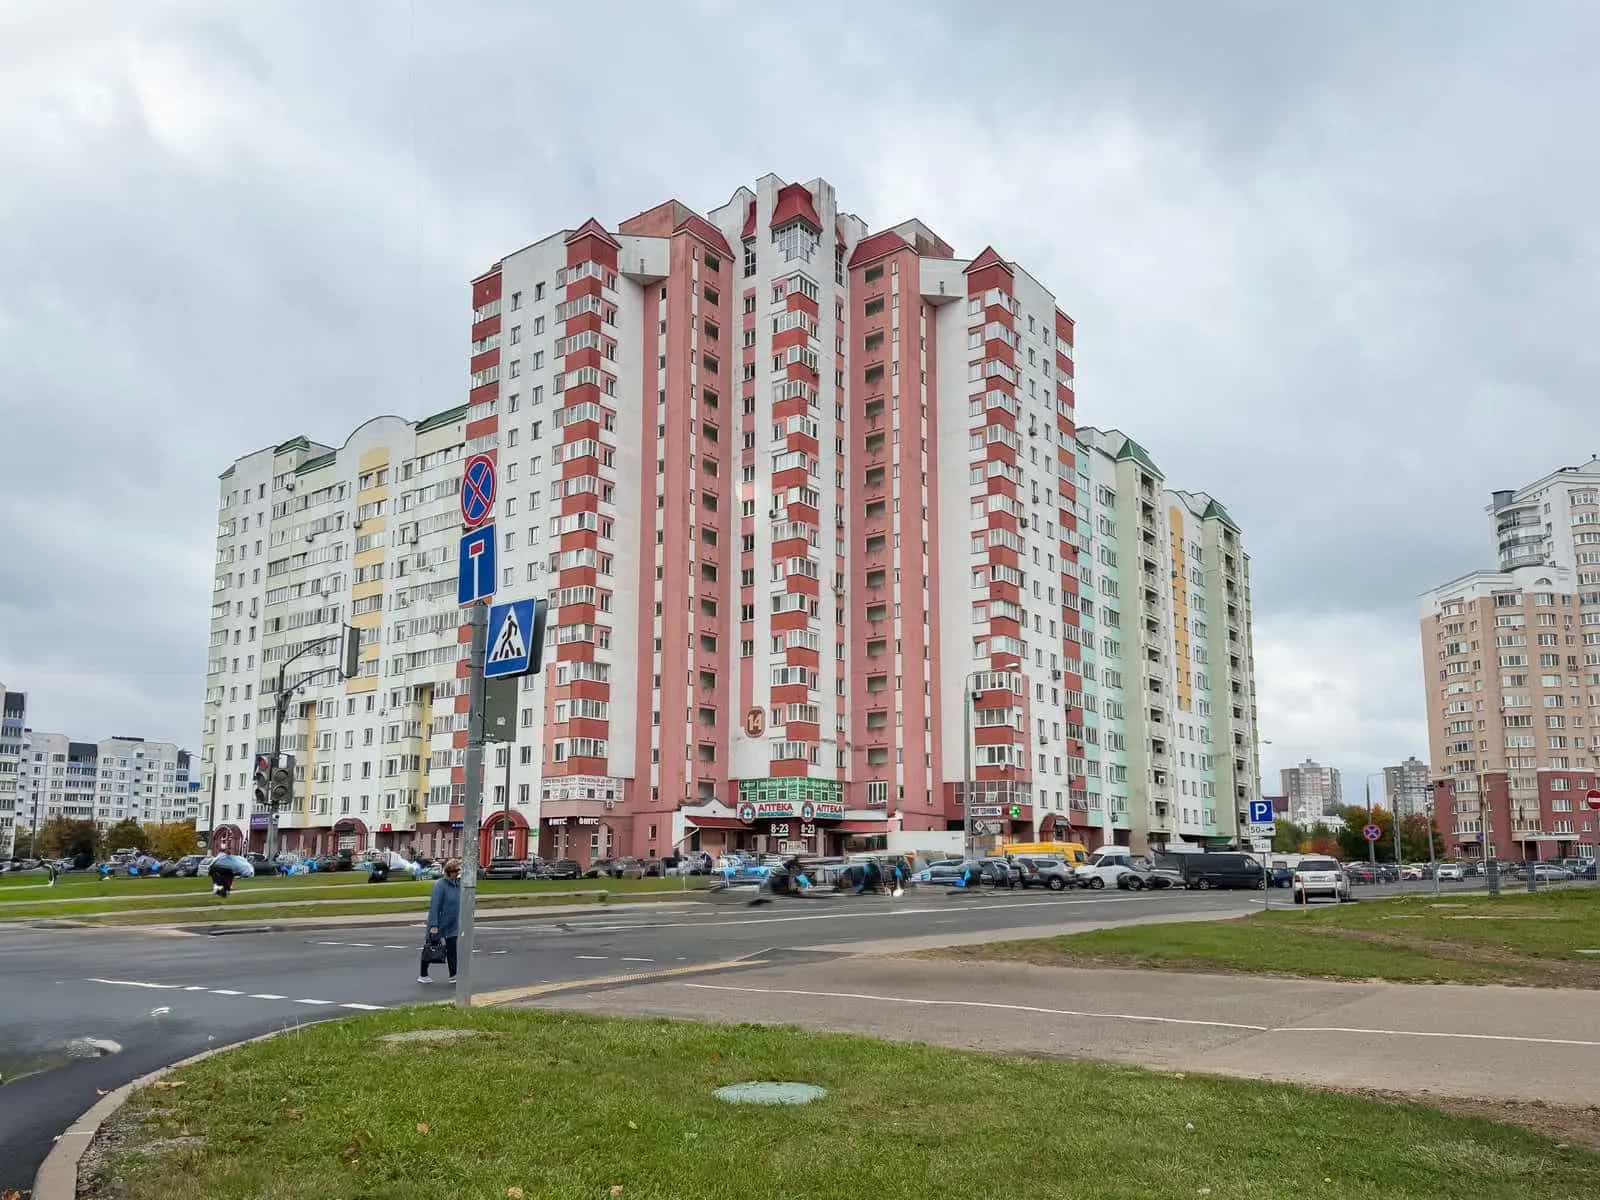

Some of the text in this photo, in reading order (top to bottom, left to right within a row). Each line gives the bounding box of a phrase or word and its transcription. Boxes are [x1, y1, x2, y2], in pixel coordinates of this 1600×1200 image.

[758, 803, 794, 812] АПТЕКА
[816, 804, 843, 813] АПТЕКА
[1255, 803, 1268, 820] P
[771, 823, 789, 833] 8-23
